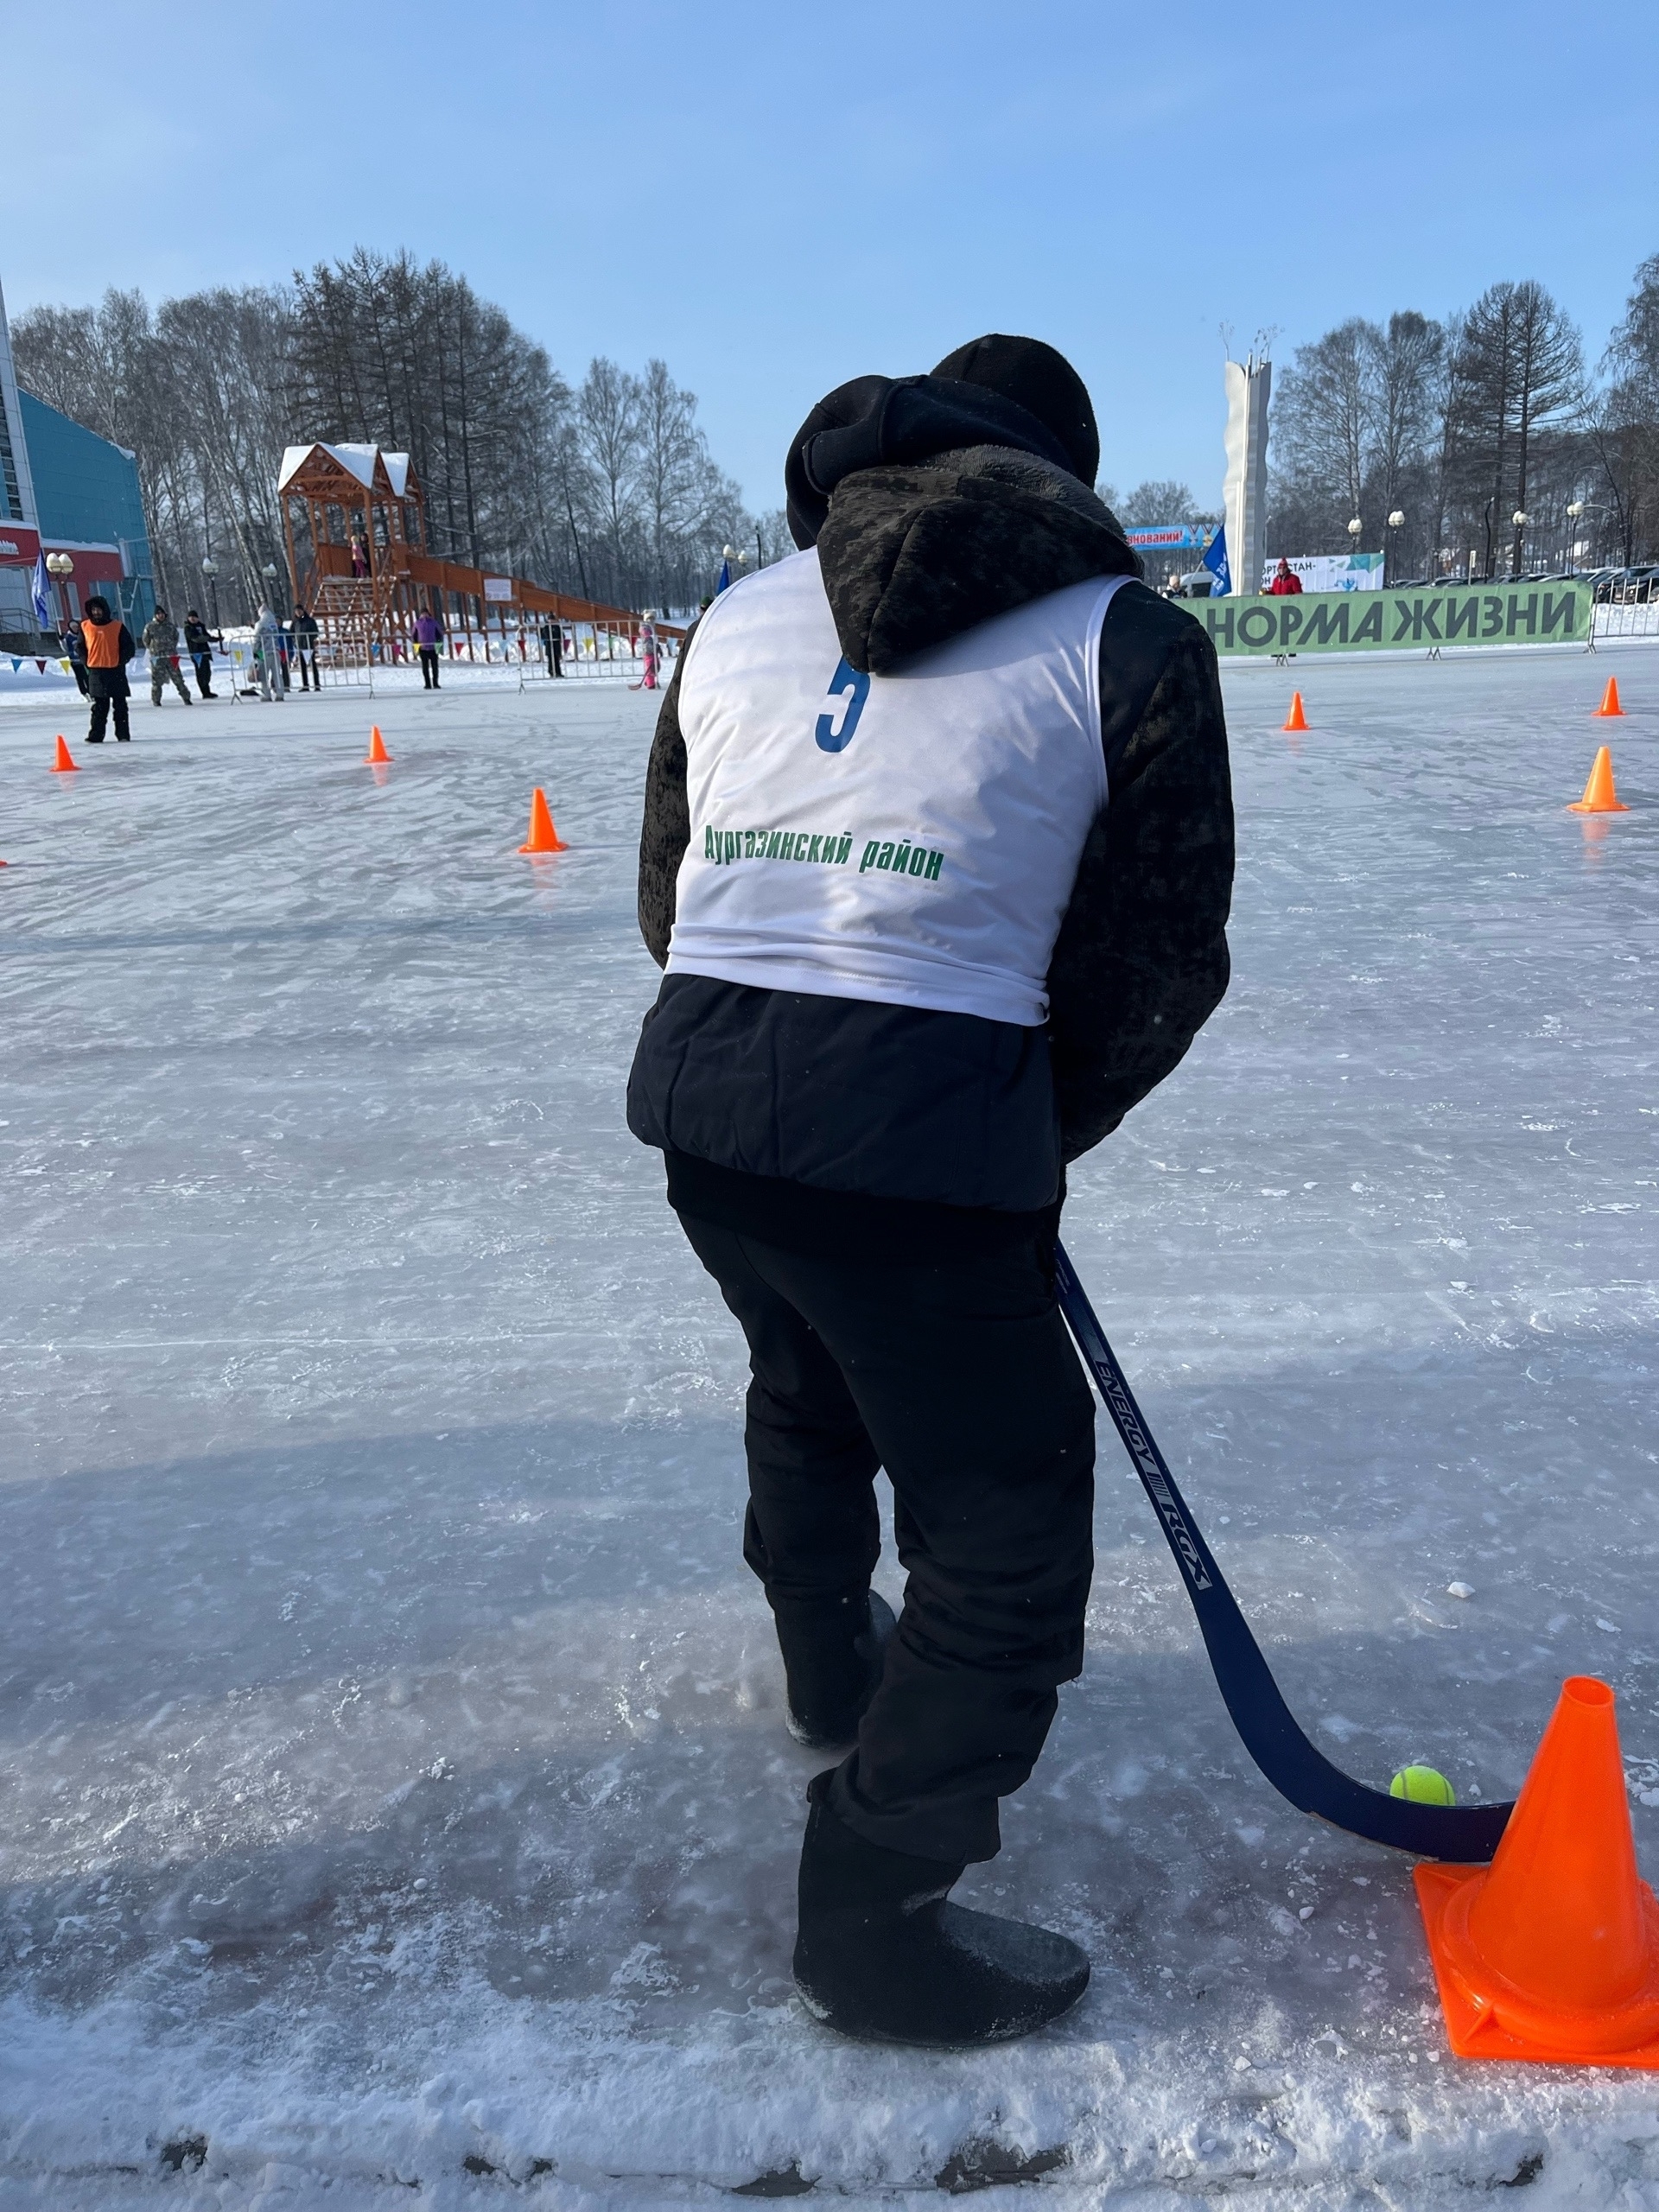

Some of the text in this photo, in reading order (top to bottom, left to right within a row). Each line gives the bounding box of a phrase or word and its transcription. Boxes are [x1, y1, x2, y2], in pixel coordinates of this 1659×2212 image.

[1127, 531, 1183, 544] внований!
[1207, 592, 1576, 648] НОРМА ЖИЗНИ
[815, 655, 871, 753] 5
[704, 824, 944, 880] Аургазинский район
[1096, 1360, 1211, 1585] ENERGY RGX
